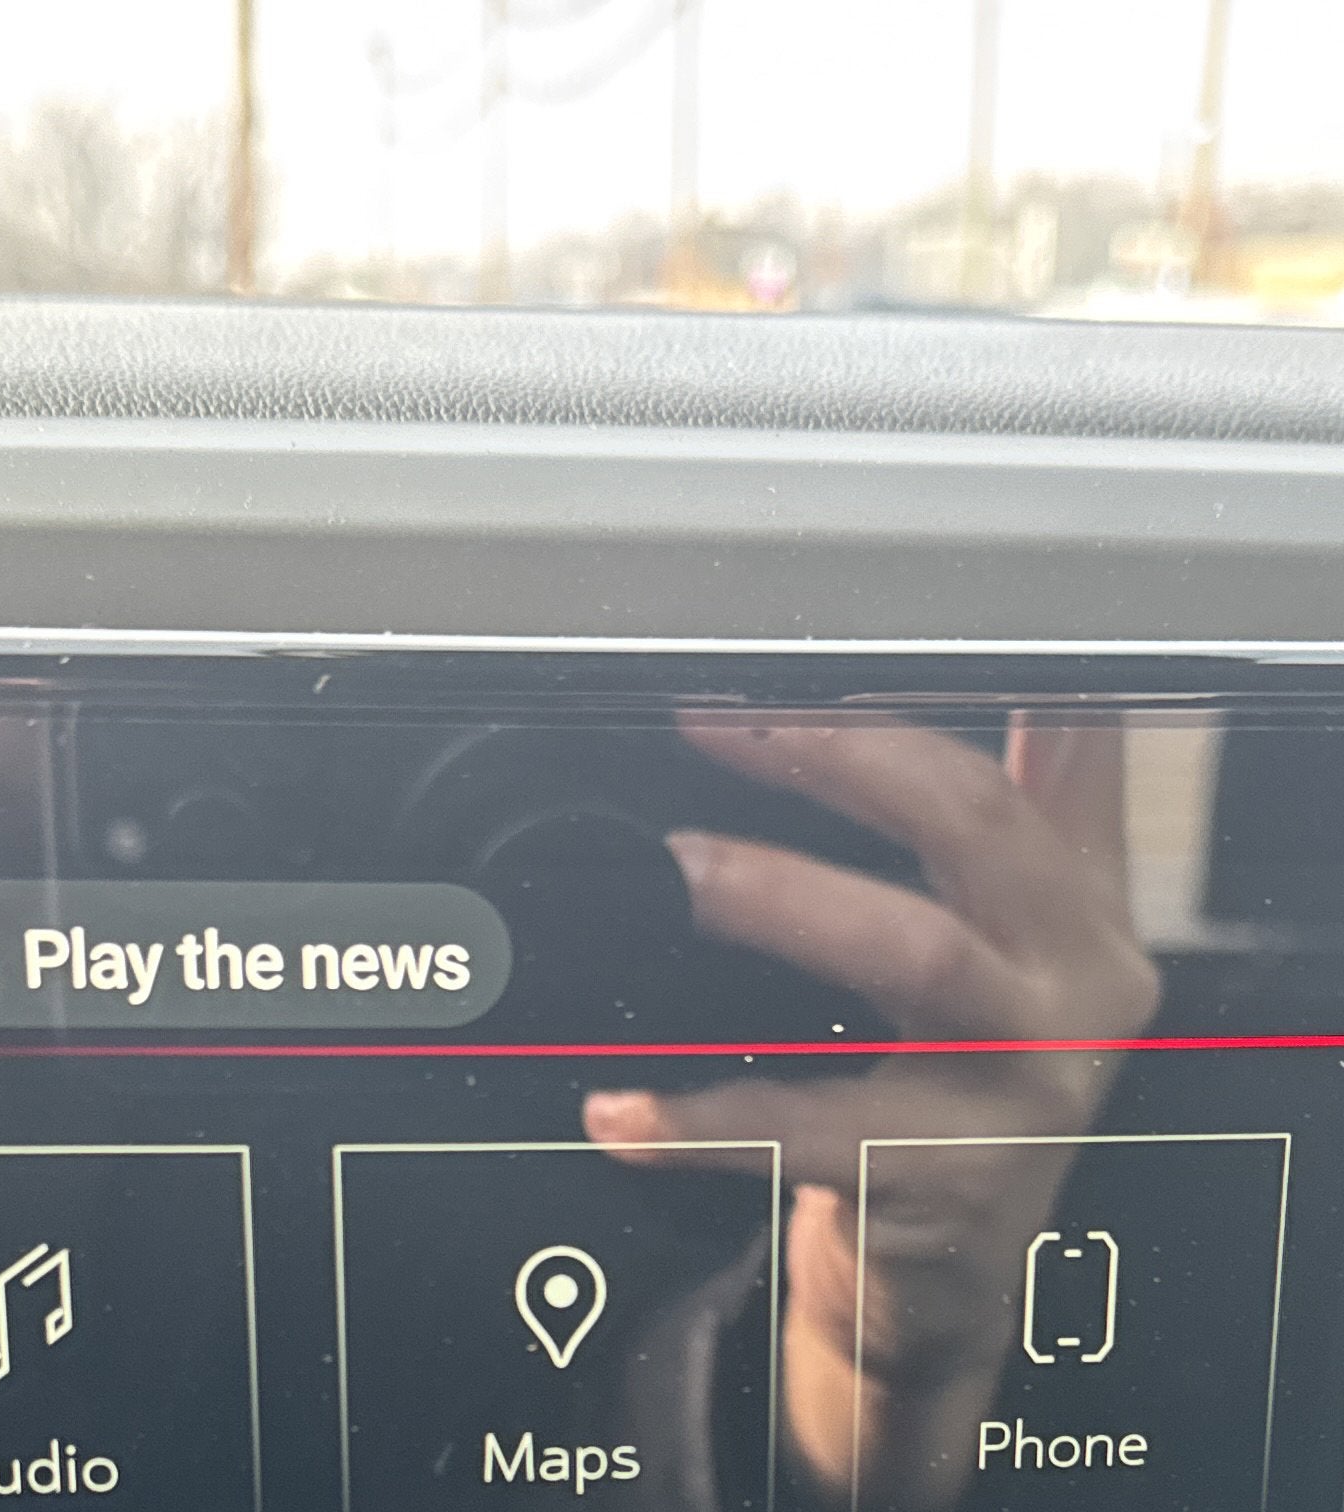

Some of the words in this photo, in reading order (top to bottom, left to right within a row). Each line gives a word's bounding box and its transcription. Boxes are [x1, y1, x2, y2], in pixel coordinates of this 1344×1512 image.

[25, 927, 163, 1005] Play
[176, 927, 284, 990] the
[302, 944, 470, 990] news
[485, 1432, 640, 1494] Maps
[979, 1418, 1147, 1469] Phone
